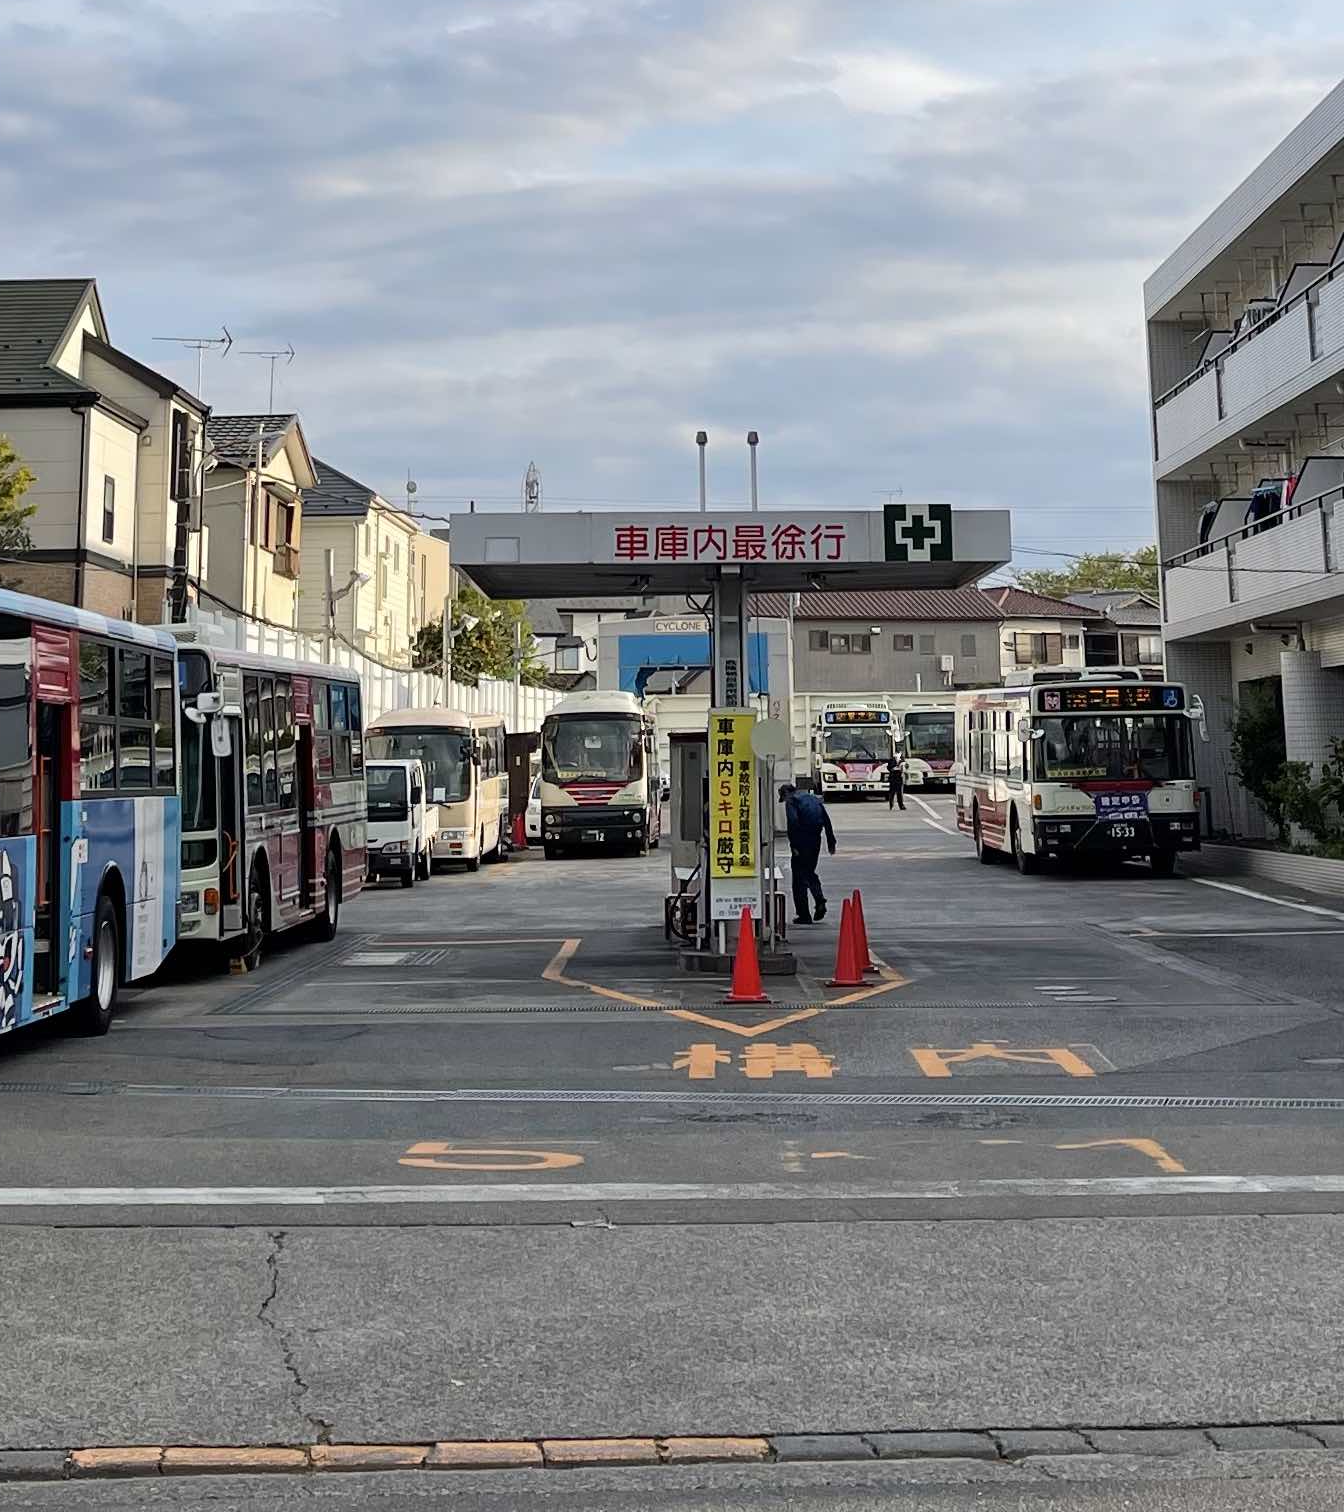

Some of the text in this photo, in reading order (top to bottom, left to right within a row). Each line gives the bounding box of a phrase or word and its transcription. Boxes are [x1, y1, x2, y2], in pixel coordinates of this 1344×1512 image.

[613, 522, 847, 561] 車庫内最徐行
[656, 621, 701, 631] CYCLONE
[716, 717, 734, 875] 車庫内5キロ厳守
[738, 760, 751, 867] 事故防止対策委員会
